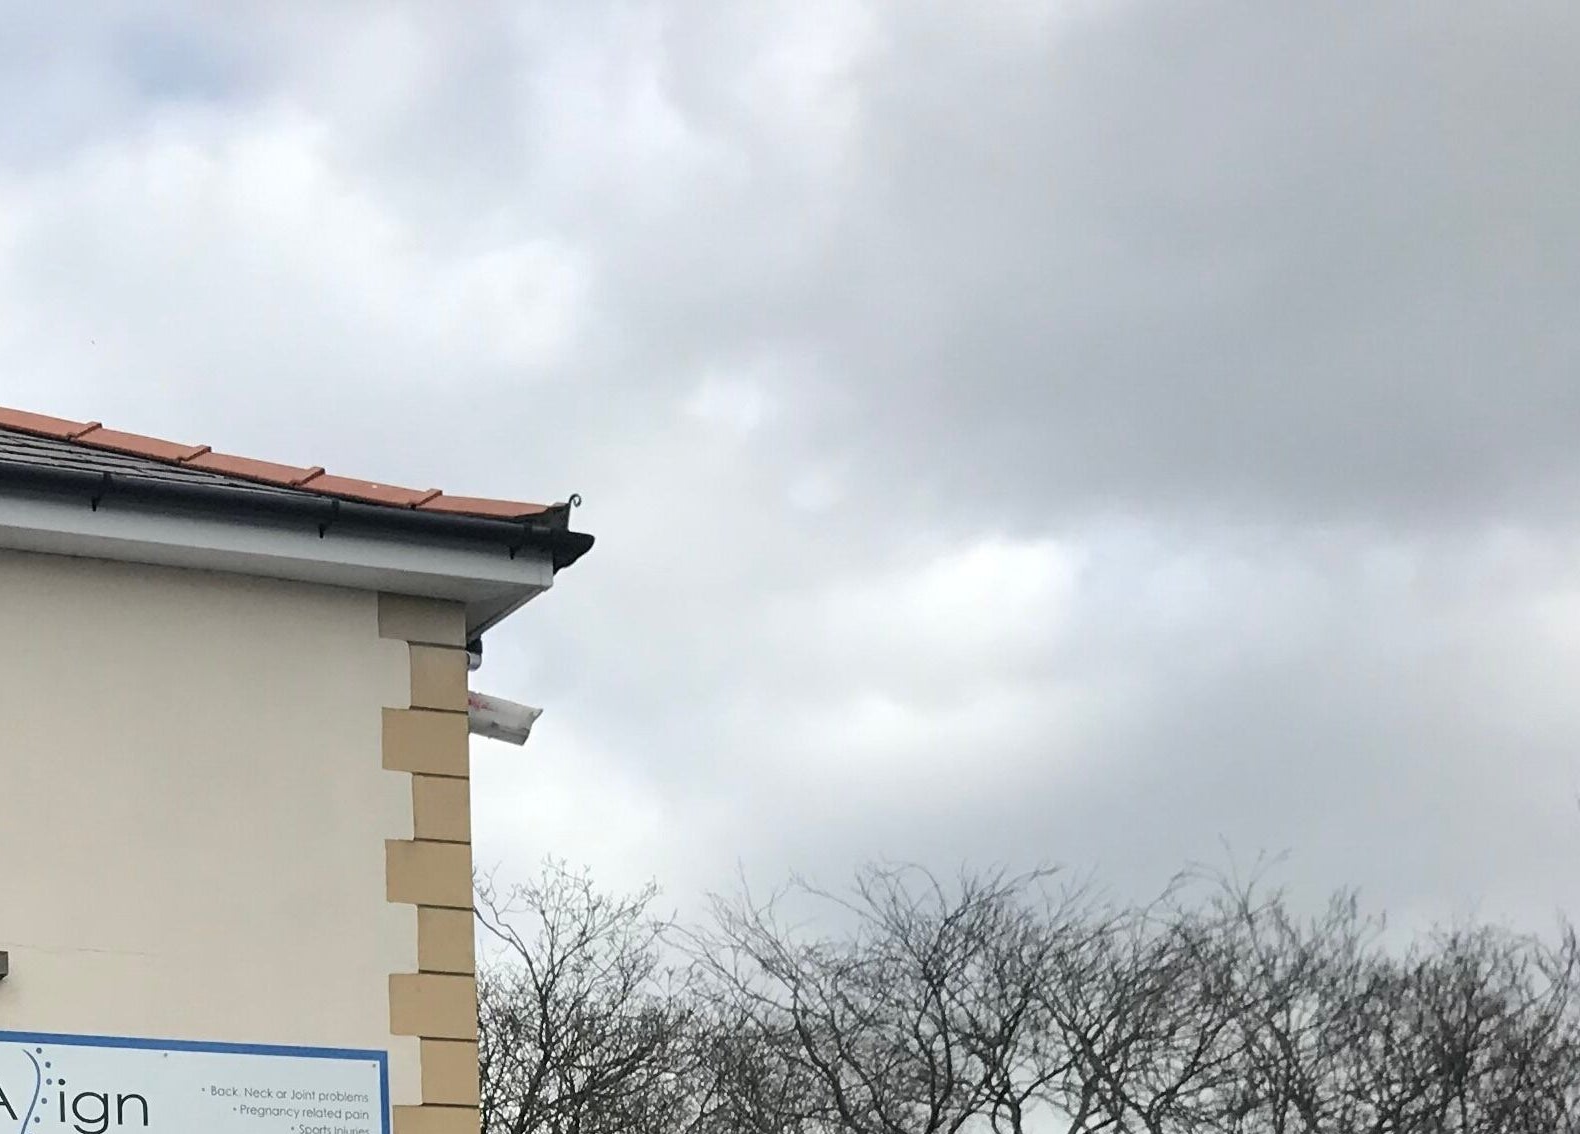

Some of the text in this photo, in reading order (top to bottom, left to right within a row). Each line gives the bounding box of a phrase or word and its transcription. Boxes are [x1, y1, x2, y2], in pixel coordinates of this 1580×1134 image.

[244, 1087, 273, 1099] Neck
[276, 1091, 287, 1099] or
[290, 1089, 315, 1101] Joint
[318, 1090, 369, 1103] problems
[240, 1104, 370, 1121] Pregnancy related pain
